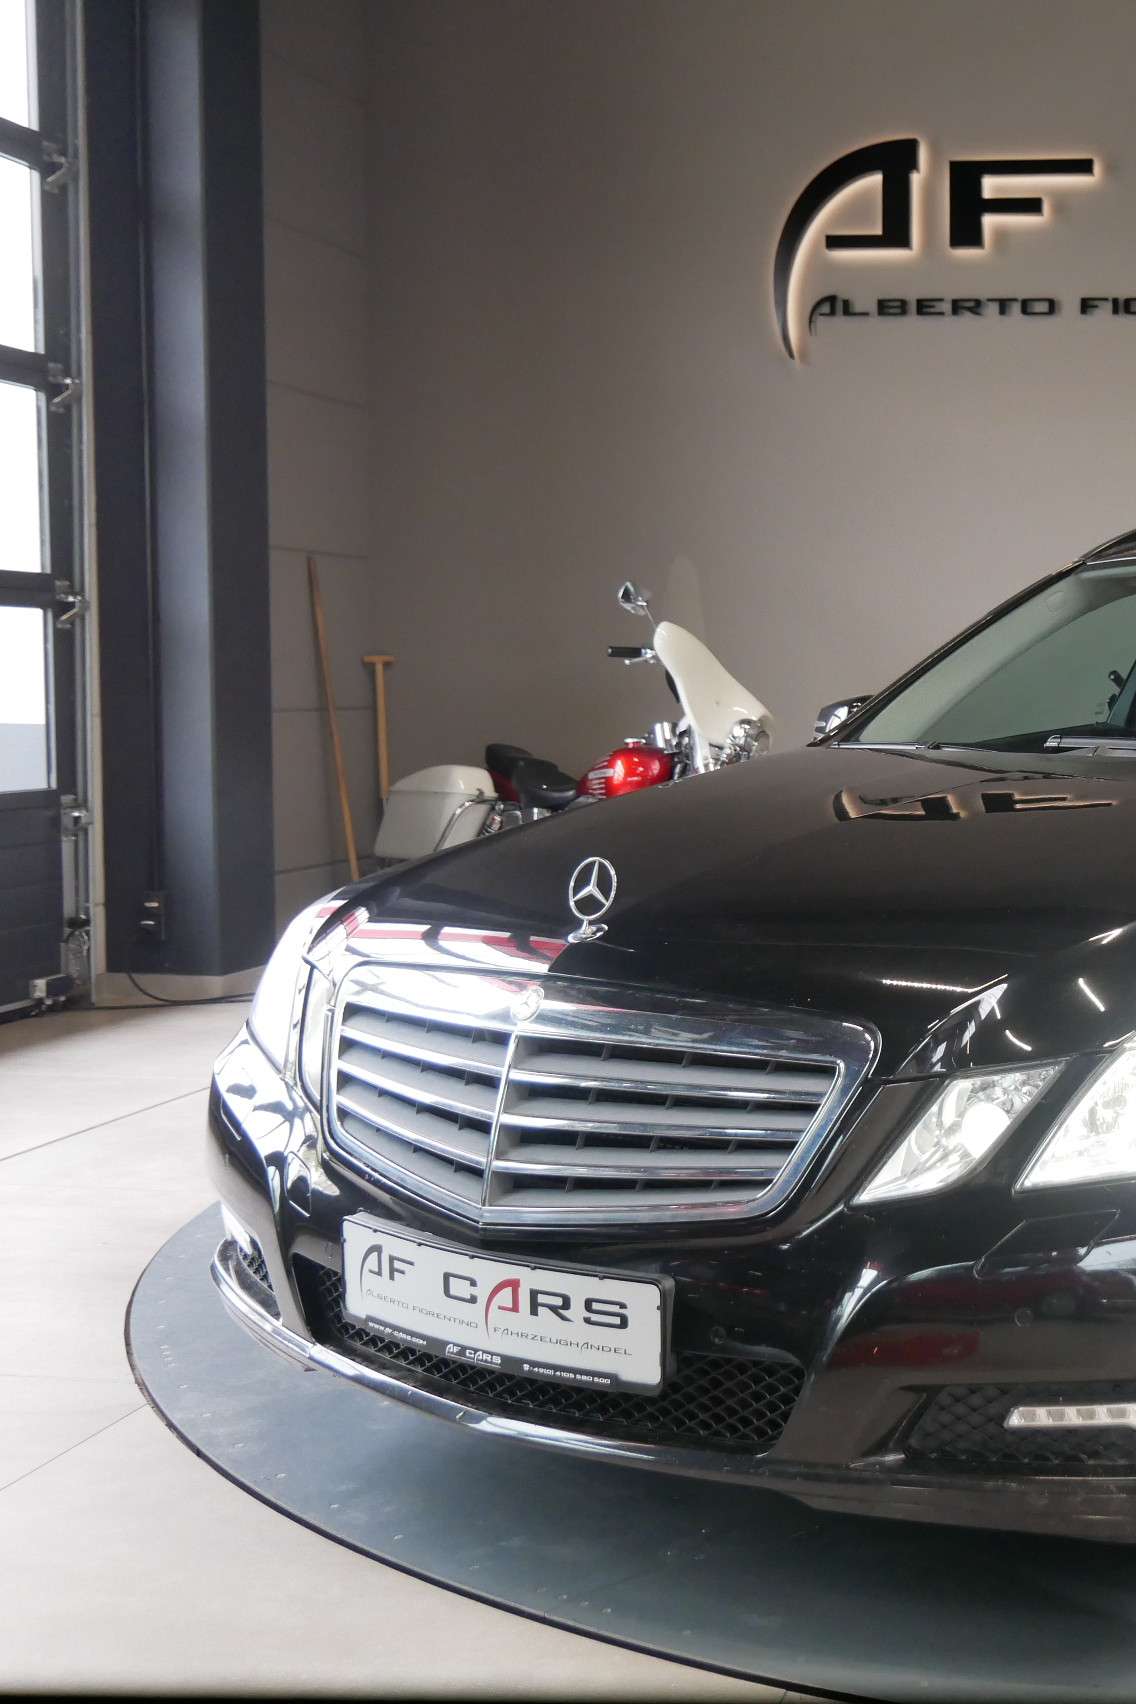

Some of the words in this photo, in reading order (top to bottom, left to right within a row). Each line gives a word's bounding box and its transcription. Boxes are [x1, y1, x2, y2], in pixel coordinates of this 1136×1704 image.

[774, 138, 1095, 360] AF
[809, 294, 1056, 336] ALBERTO
[360, 1244, 415, 1302] AF
[442, 1271, 630, 1338] CARS
[365, 1289, 409, 1310] ALBERTO
[412, 1305, 478, 1329] FIORENTINO
[493, 1326, 633, 1357] FAHRZEUGHANDEL
[445, 1343, 461, 1357] AF
[465, 1349, 501, 1365] CARS
